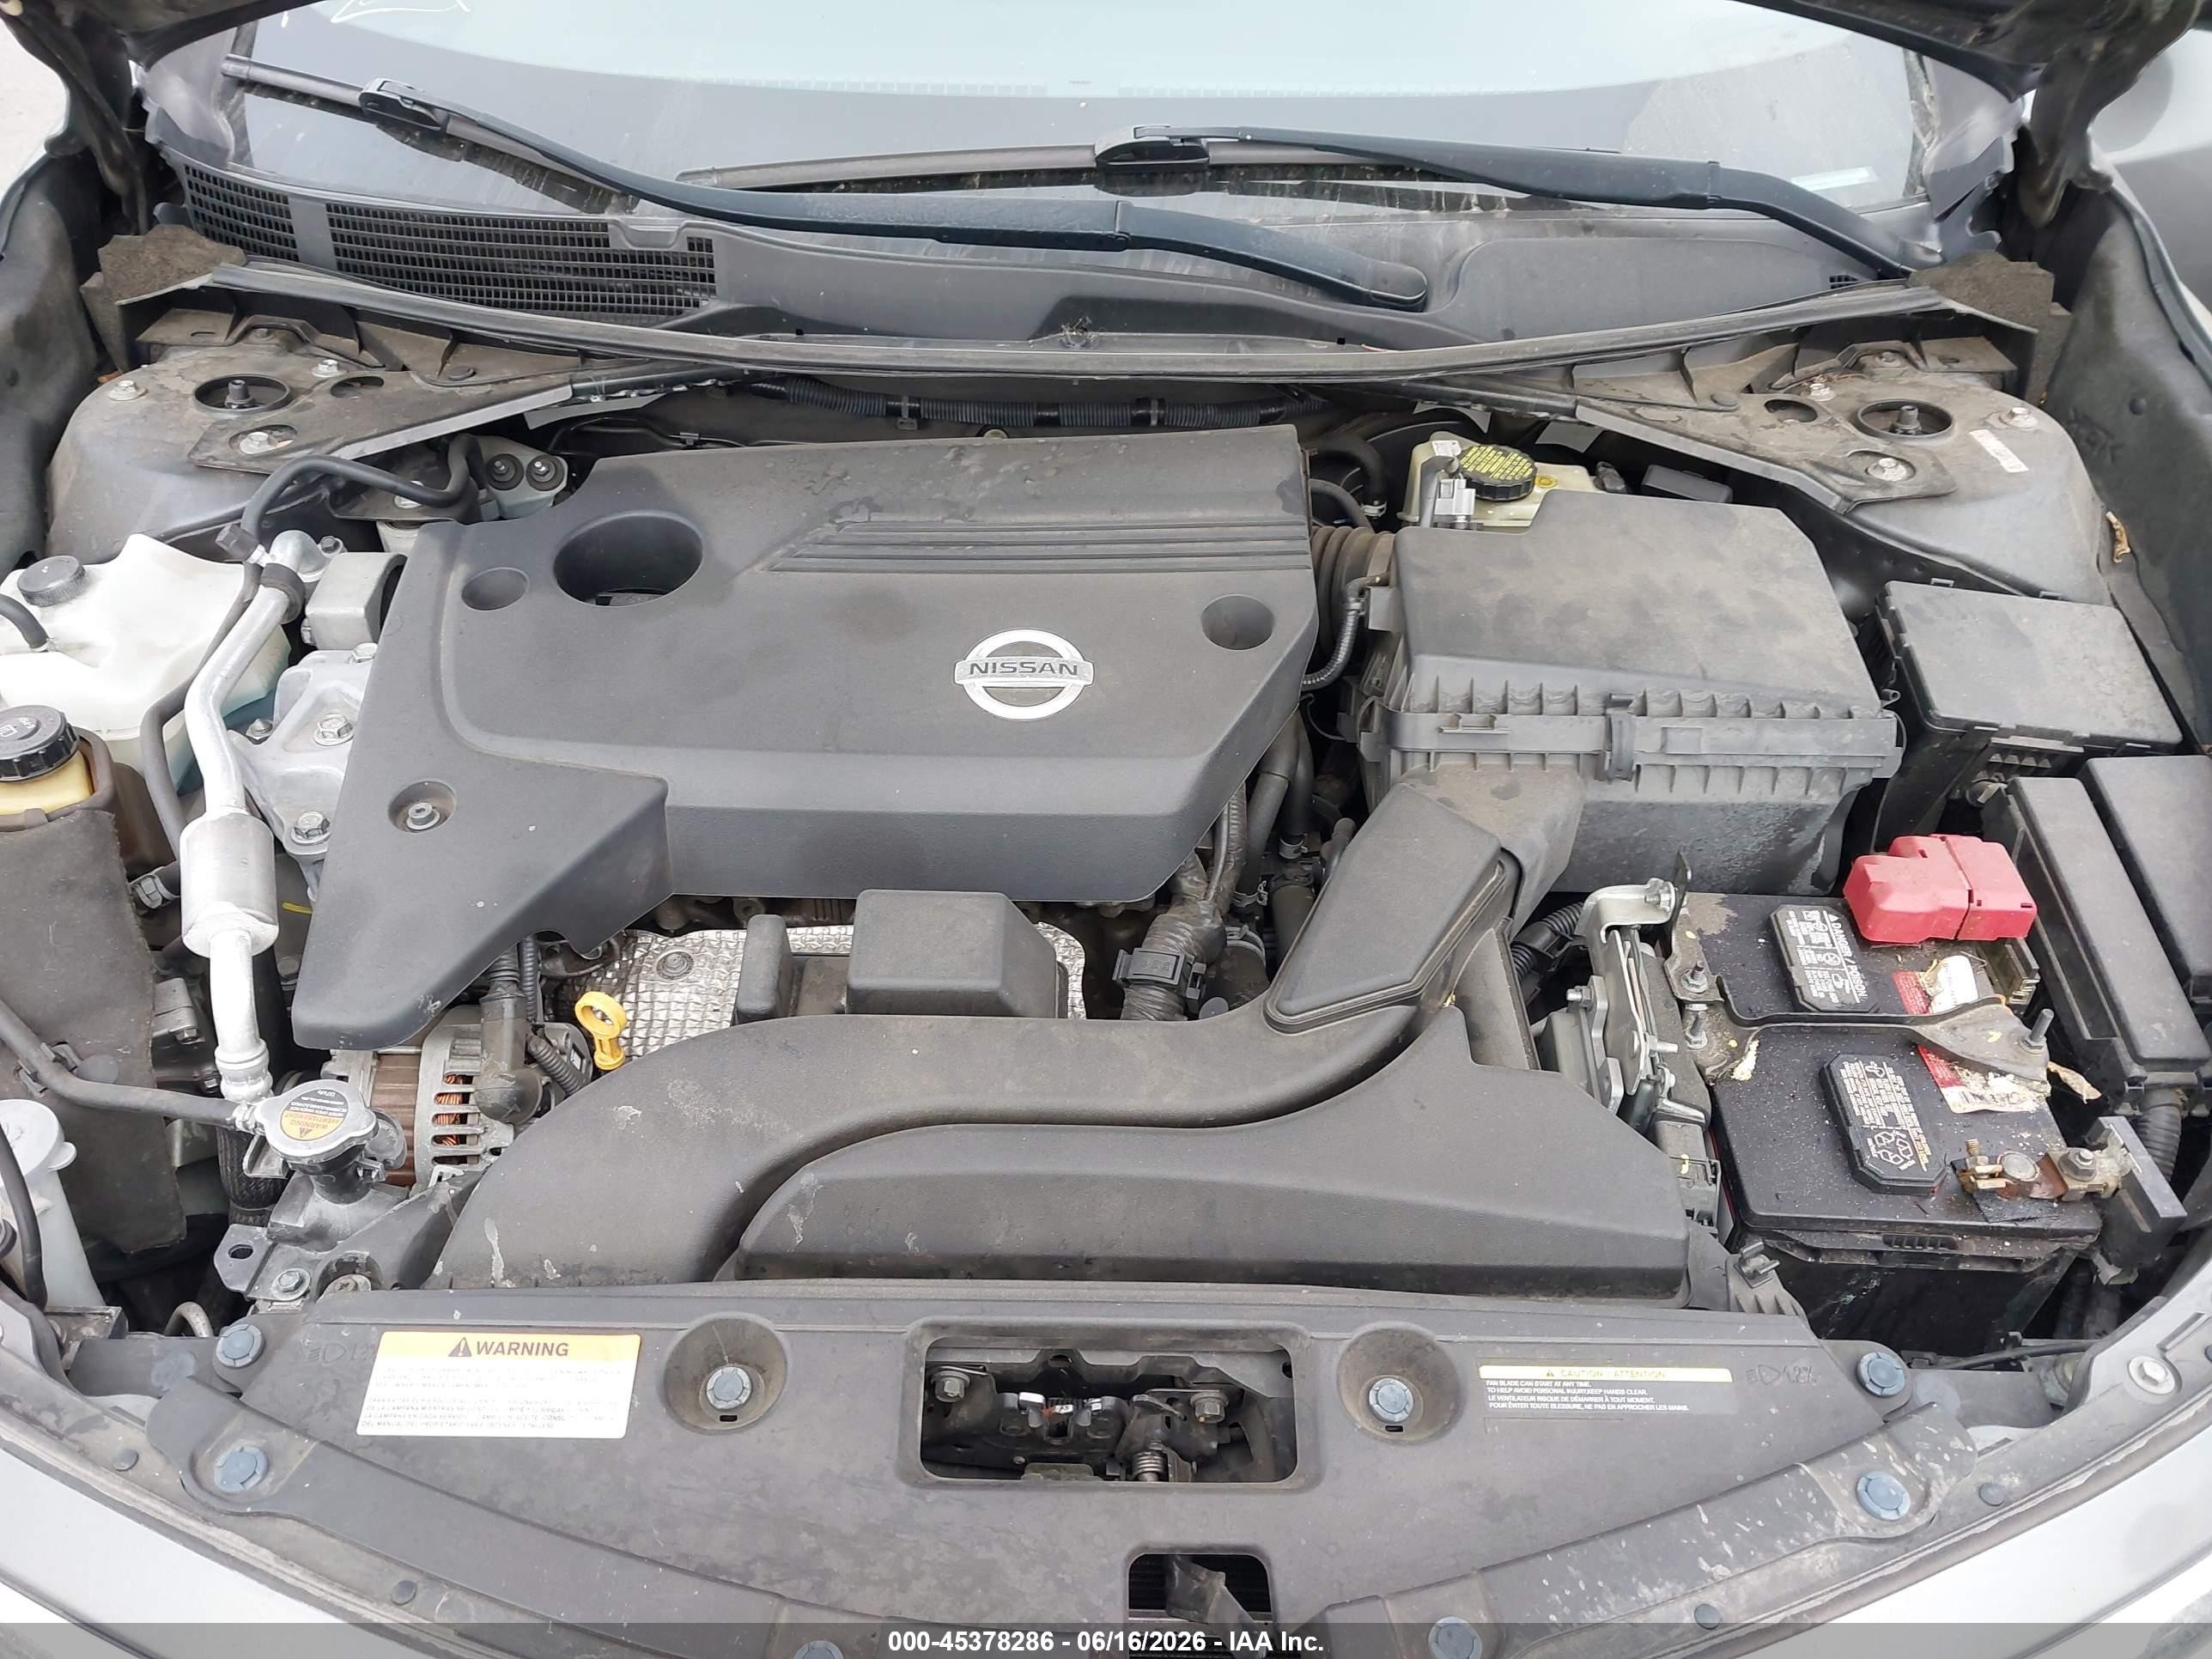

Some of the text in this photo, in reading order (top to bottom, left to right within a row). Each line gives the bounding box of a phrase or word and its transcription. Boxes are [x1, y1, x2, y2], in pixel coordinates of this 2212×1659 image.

[969, 661, 1079, 676] NISSAN
[1831, 922, 1853, 957] DANGER
[1848, 964, 1869, 997] POISON
[290, 1119, 328, 1129] WARNING
[476, 1341, 569, 1357] WARNING
